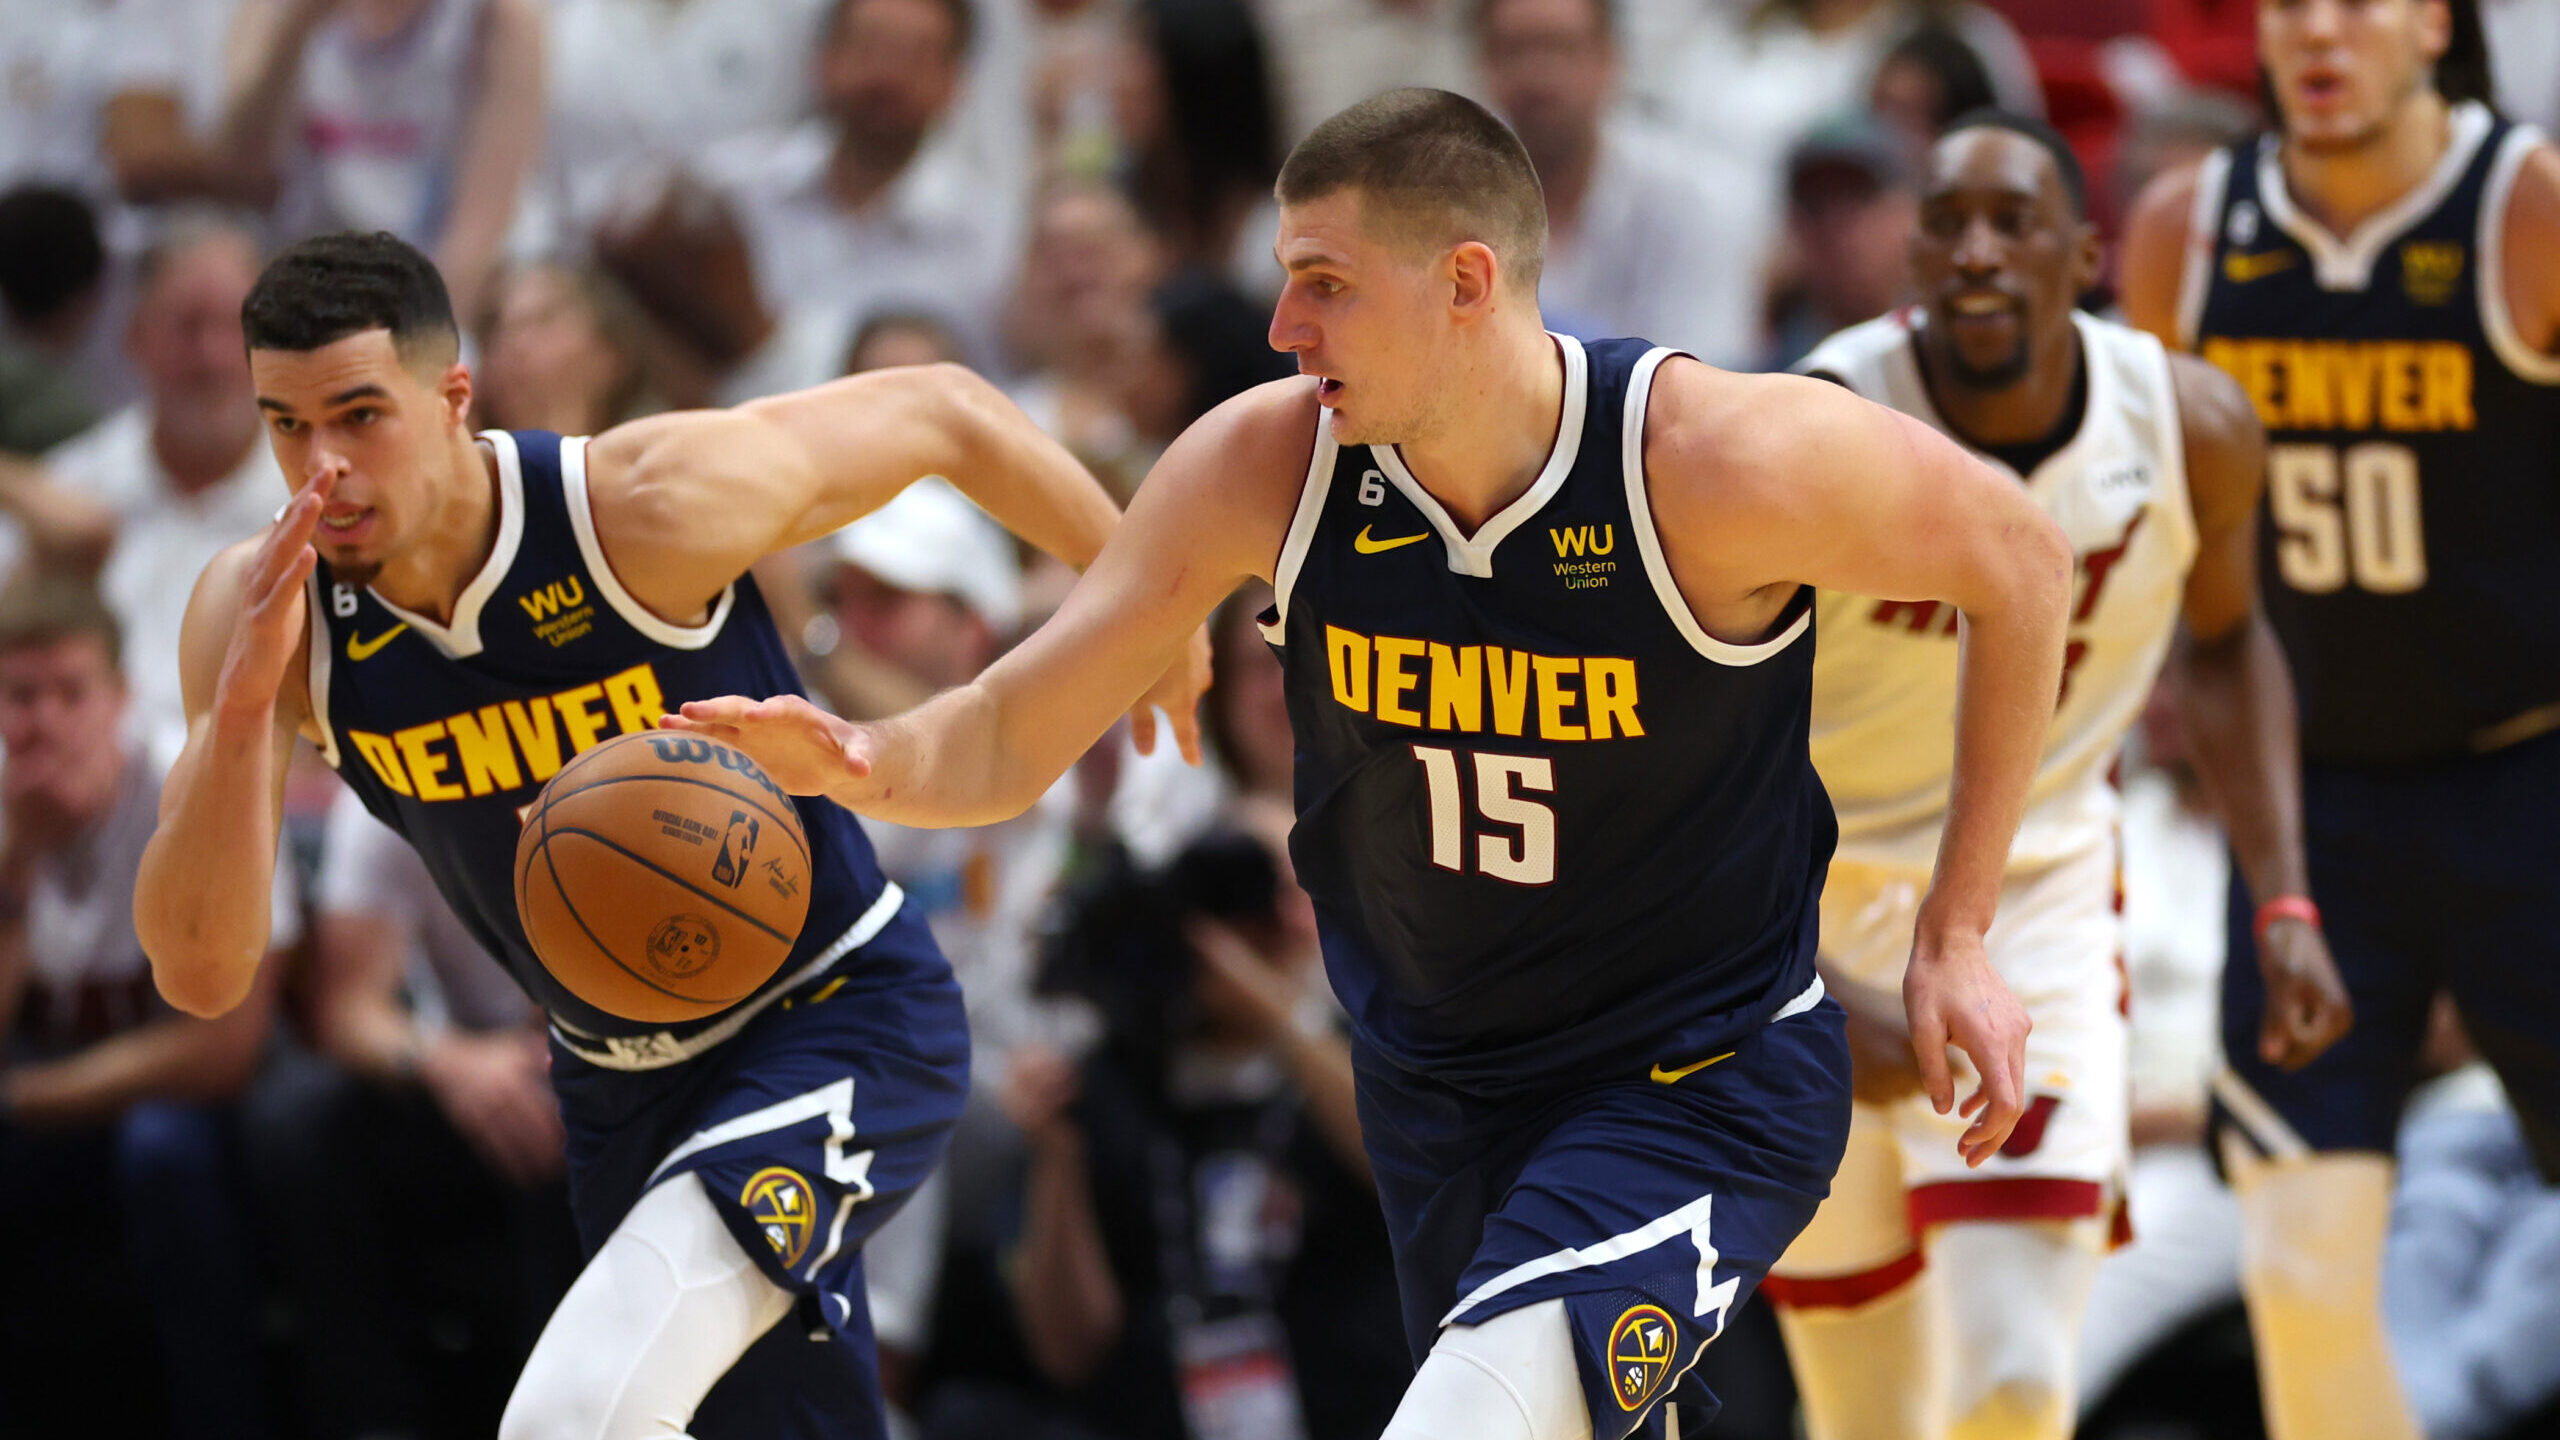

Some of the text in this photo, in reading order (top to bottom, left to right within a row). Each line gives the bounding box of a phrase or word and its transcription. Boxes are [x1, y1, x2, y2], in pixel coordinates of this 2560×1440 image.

[1358, 469, 1386, 507] 6
[2269, 442, 2428, 594] 50
[1549, 524, 1614, 558] WU
[1553, 561, 1616, 576] Western
[1565, 574, 1608, 590] Union
[333, 583, 358, 618] 6
[518, 575, 584, 622] WU
[1325, 623, 1646, 741] DENVER
[348, 661, 668, 802] DENVER
[1409, 744, 1559, 886] 15
